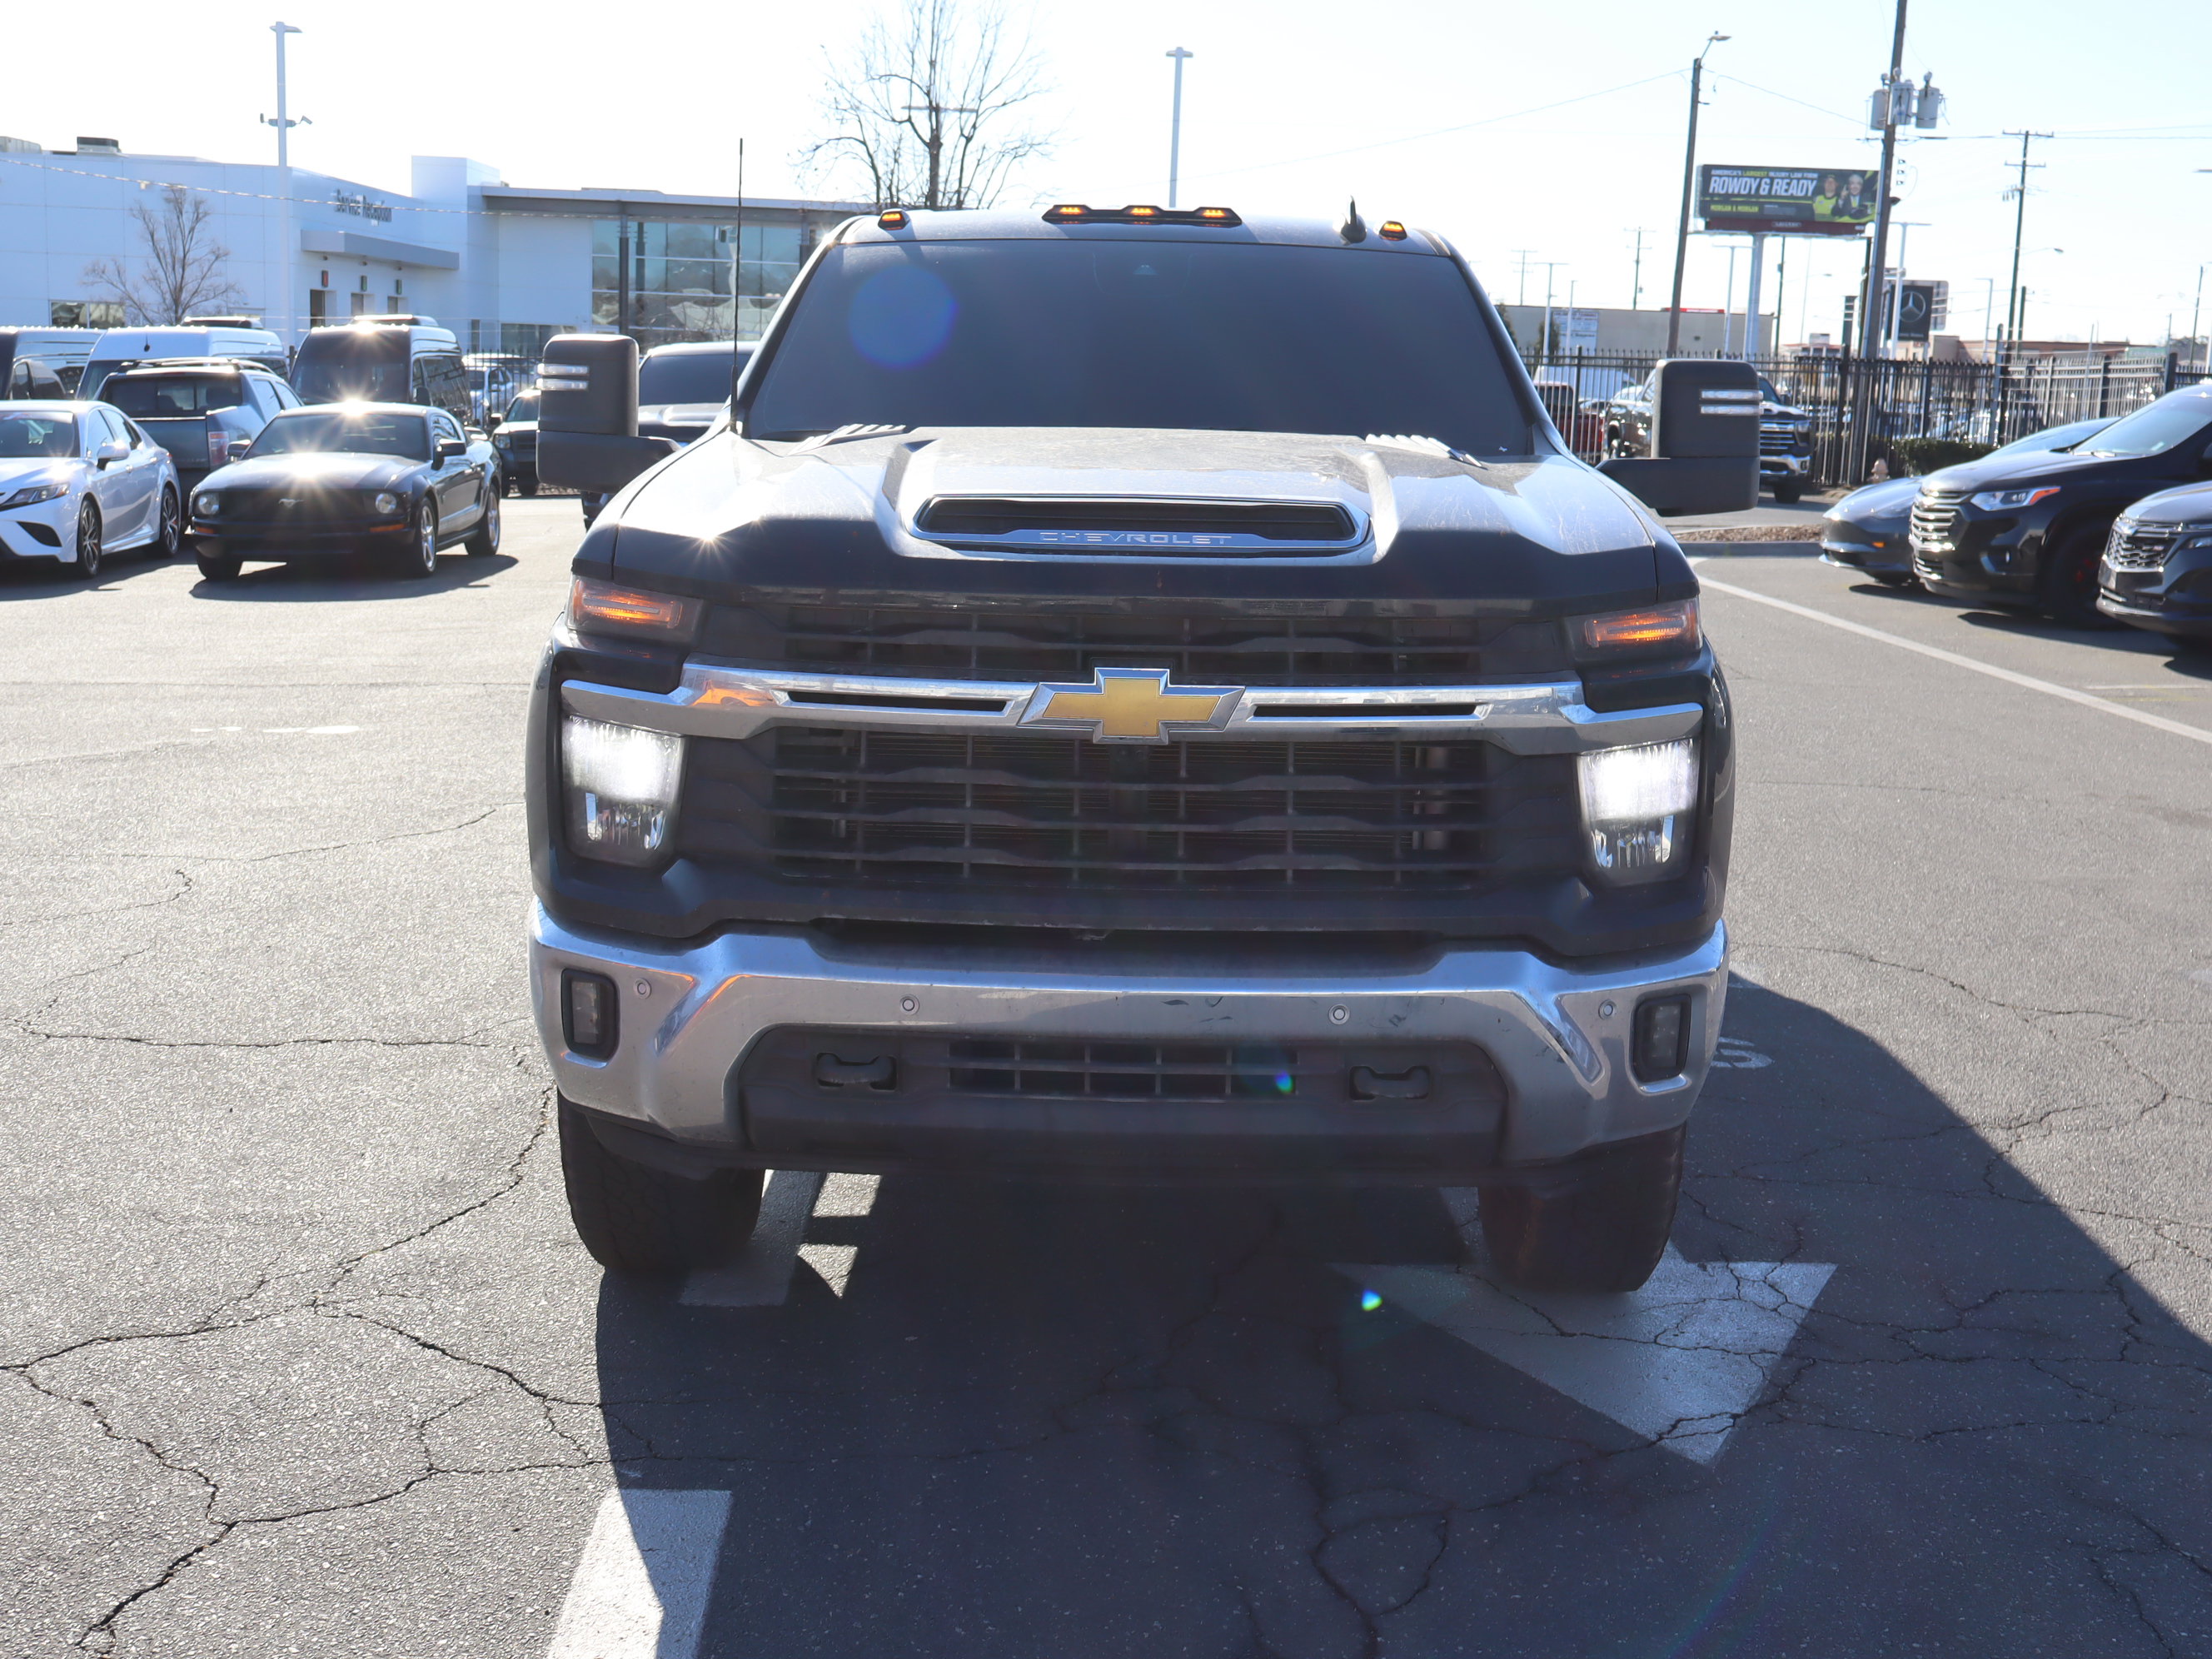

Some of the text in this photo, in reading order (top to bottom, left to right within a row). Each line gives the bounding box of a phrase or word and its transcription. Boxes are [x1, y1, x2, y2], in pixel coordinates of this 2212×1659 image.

[1709, 177, 1817, 197] ROWDY & READY
[1039, 531, 1233, 546] CHEVROLET
